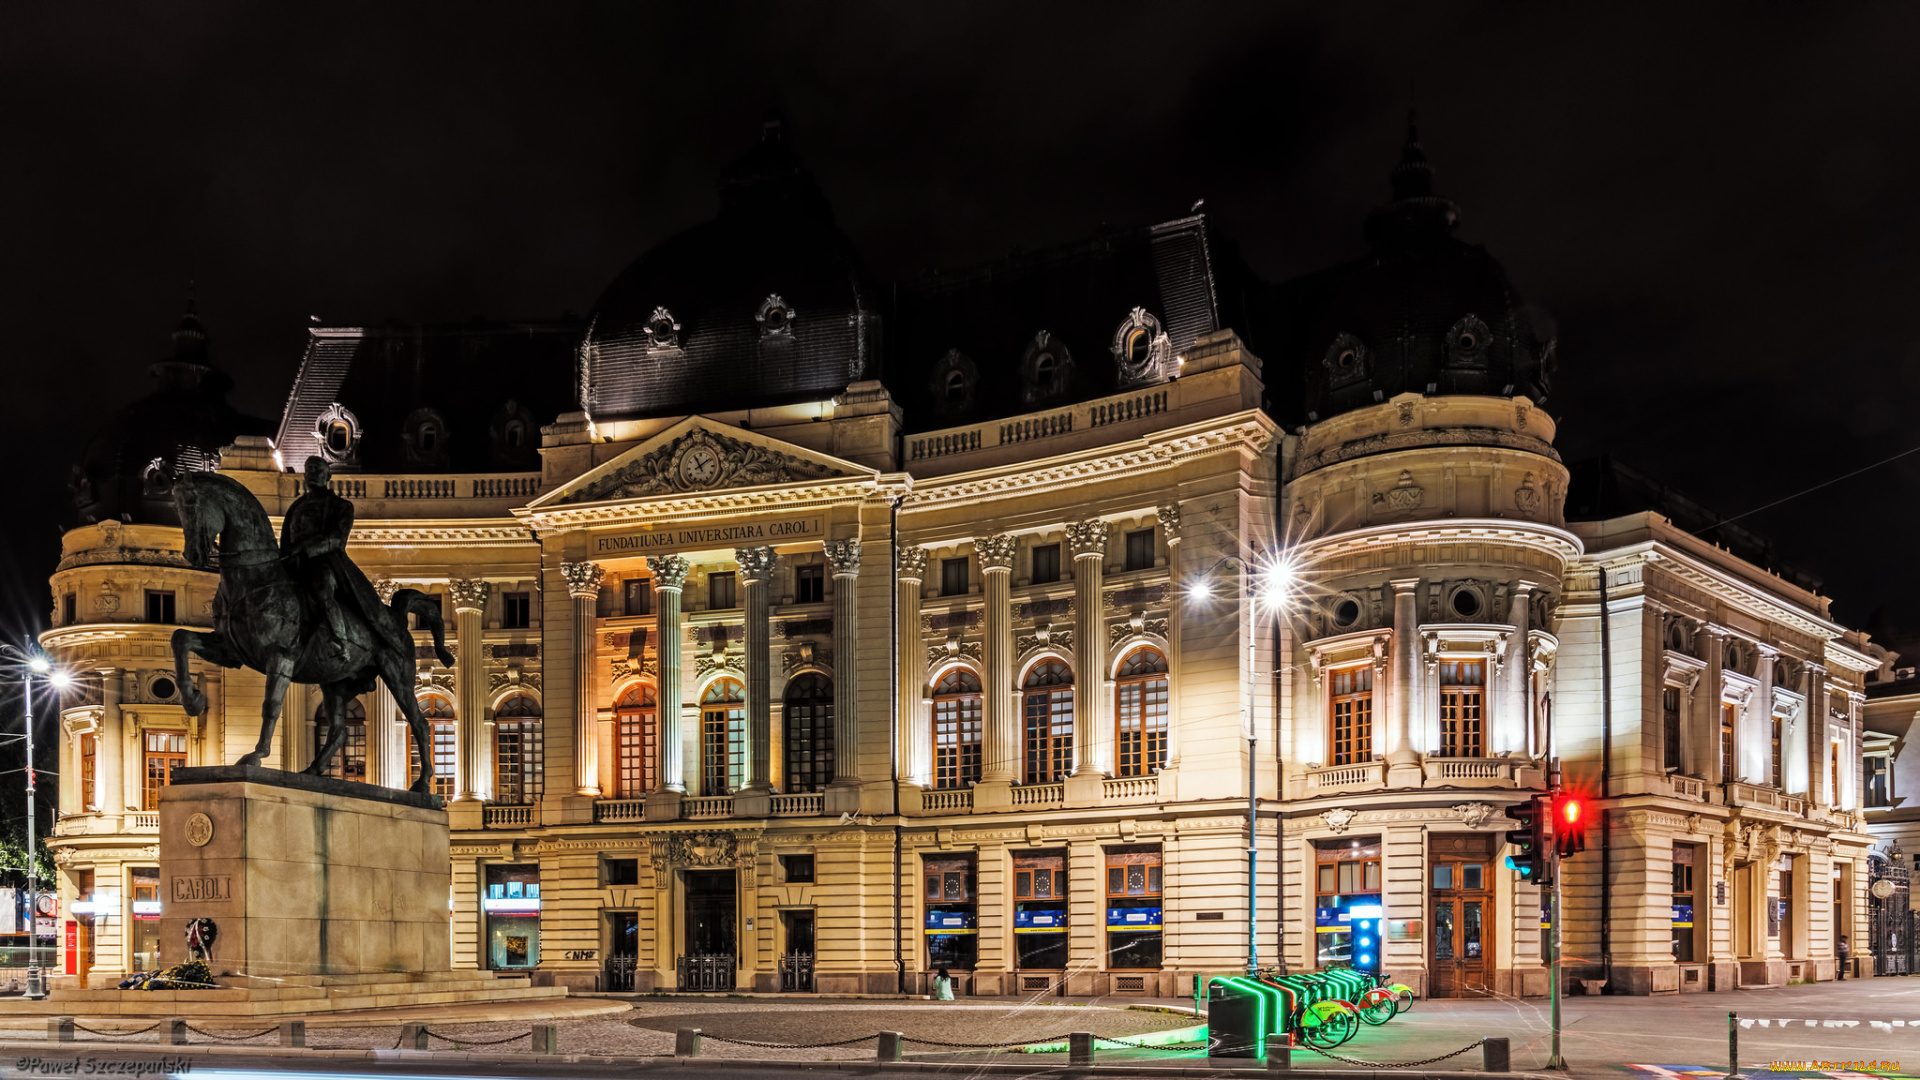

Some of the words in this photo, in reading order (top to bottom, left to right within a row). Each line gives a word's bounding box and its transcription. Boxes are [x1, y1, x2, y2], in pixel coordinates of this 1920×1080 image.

[598, 533, 674, 551] FUNDATIUNEA
[679, 525, 763, 543] UNIVERSITARA
[769, 520, 809, 536] CAROL
[814, 519, 819, 532] I
[176, 878, 222, 900] CAROL
[224, 877, 231, 899] I
